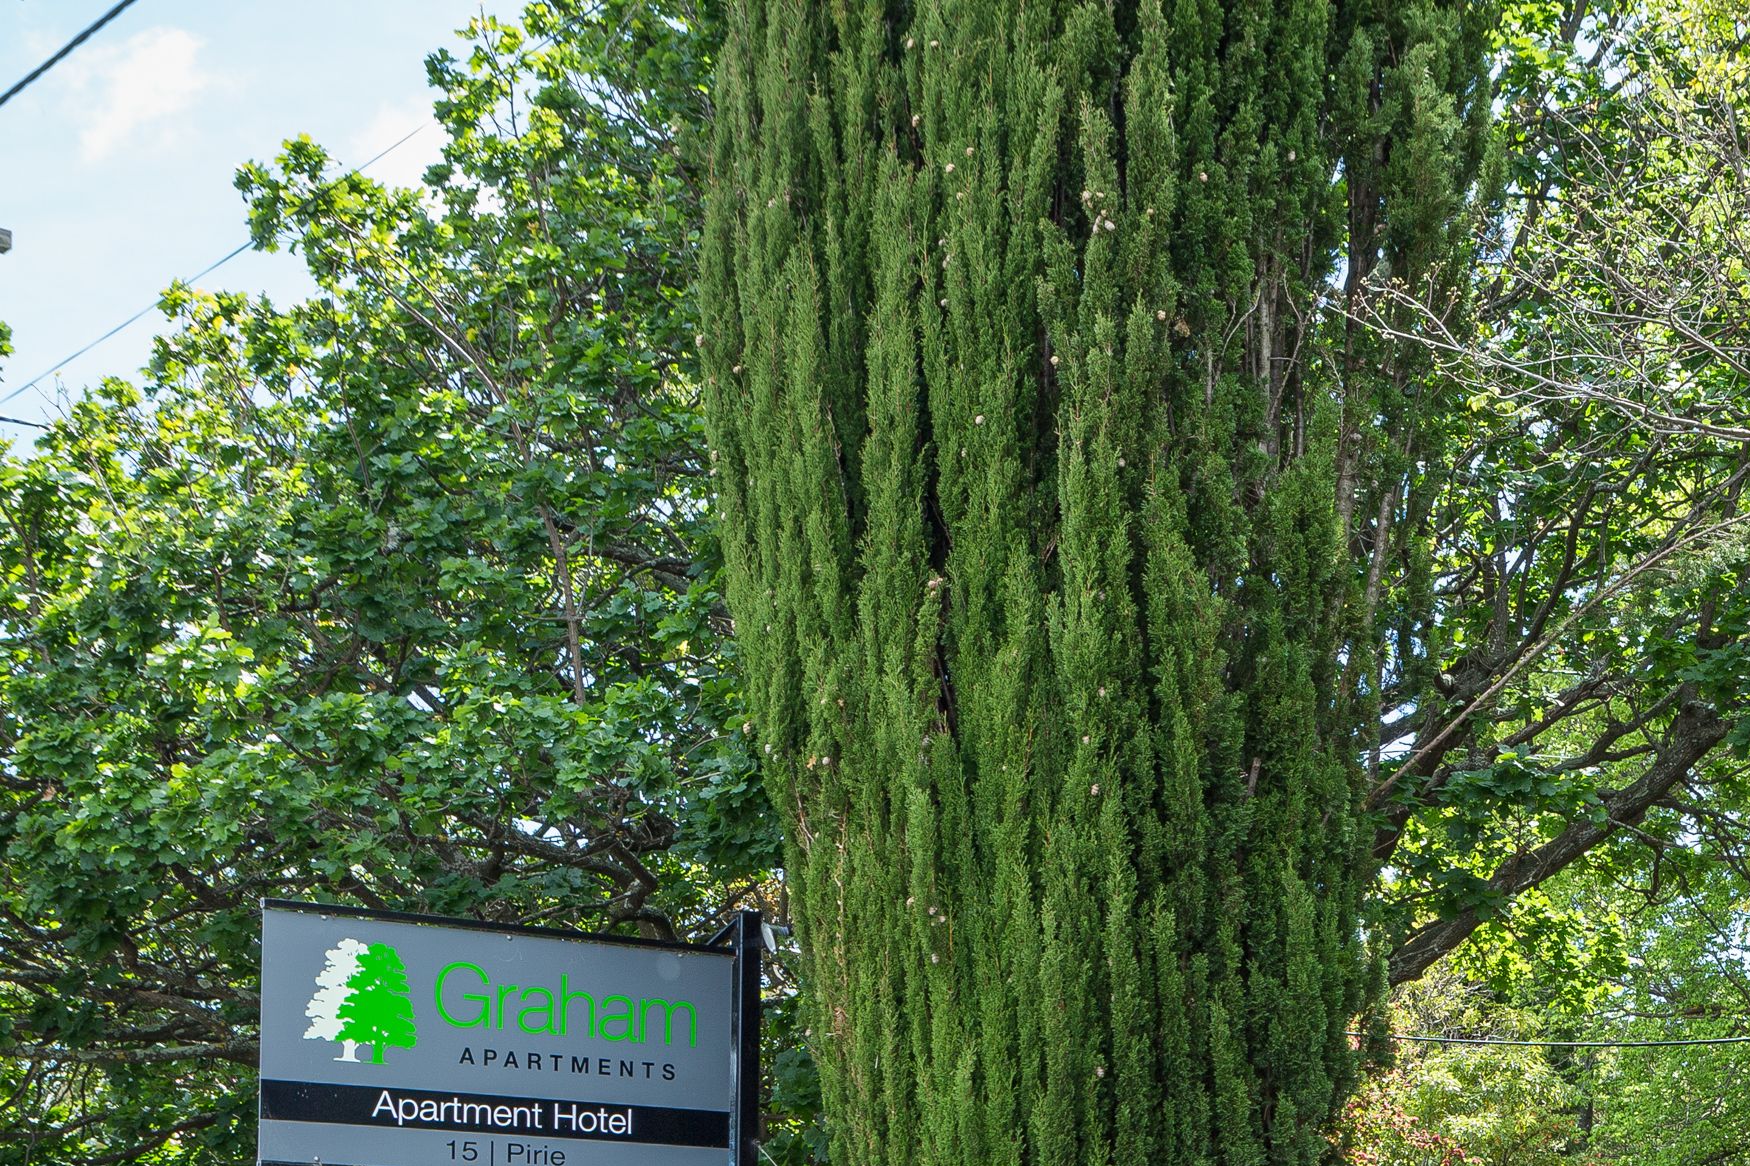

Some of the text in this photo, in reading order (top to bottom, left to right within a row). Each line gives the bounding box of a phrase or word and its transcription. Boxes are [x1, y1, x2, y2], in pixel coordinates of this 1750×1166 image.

[434, 961, 697, 1048] Graham
[459, 1047, 676, 1081] APARTMENTS
[372, 1090, 633, 1135] Apartment Hotel
[446, 1139, 478, 1162] 15
[507, 1142, 566, 1166] Pirie
